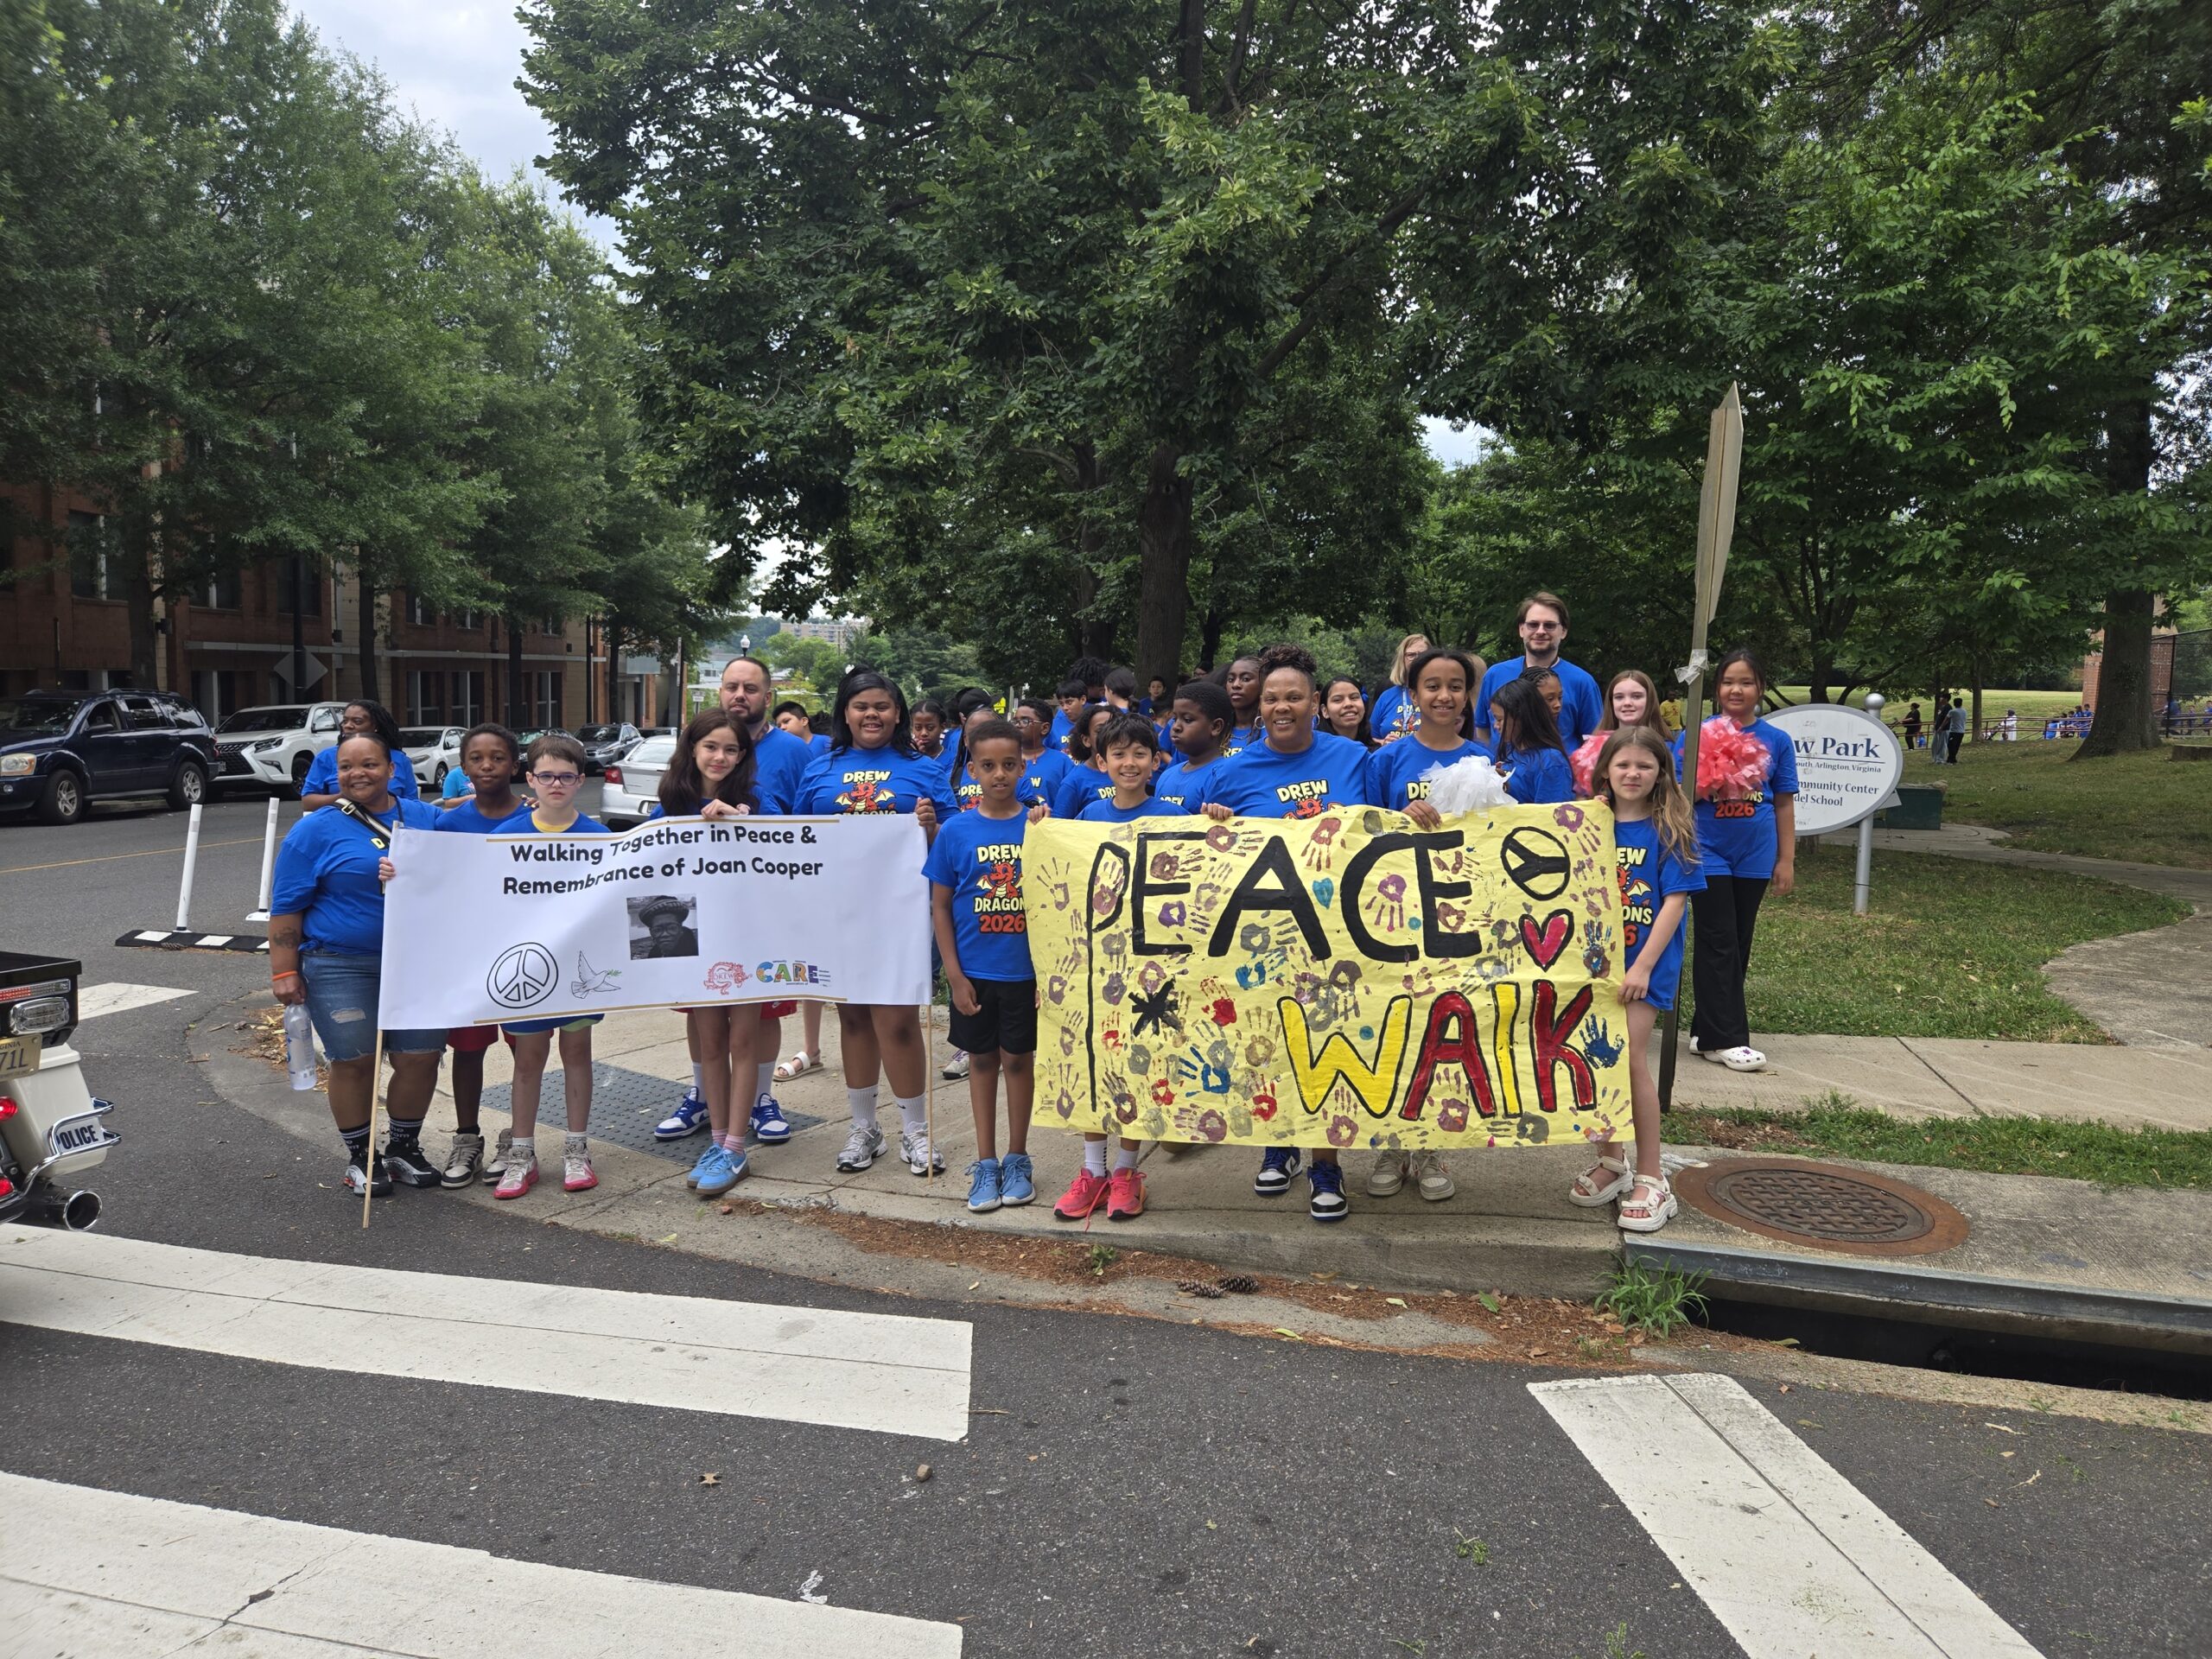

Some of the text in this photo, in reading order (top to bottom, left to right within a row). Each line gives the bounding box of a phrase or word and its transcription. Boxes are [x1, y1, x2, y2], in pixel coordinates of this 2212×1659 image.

[1821, 737, 1881, 759] Park
[842, 770, 892, 784] DREW
[1852, 764, 1881, 773] Virginia
[961, 784, 983, 796] DRE
[1097, 786, 1116, 799] DRE
[1276, 779, 1328, 803] DREW
[1407, 781, 1431, 799] DR
[1798, 780, 1879, 794] mmunity Center
[1794, 793, 1843, 806] del School
[1714, 802, 1755, 818] 2026
[511, 823, 817, 865] Walking Together in Peace &
[1616, 847, 1647, 865] EW
[503, 856, 823, 894] Remembrance of Joan Cooper
[974, 896, 1026, 912] DRAGON
[979, 913, 1027, 932] 2026
[756, 961, 820, 984] CARE
[1086, 830, 1482, 1113] PEACE
[0, 1040, 21, 1050] GINIA
[0, 1048, 29, 1071] 71L
